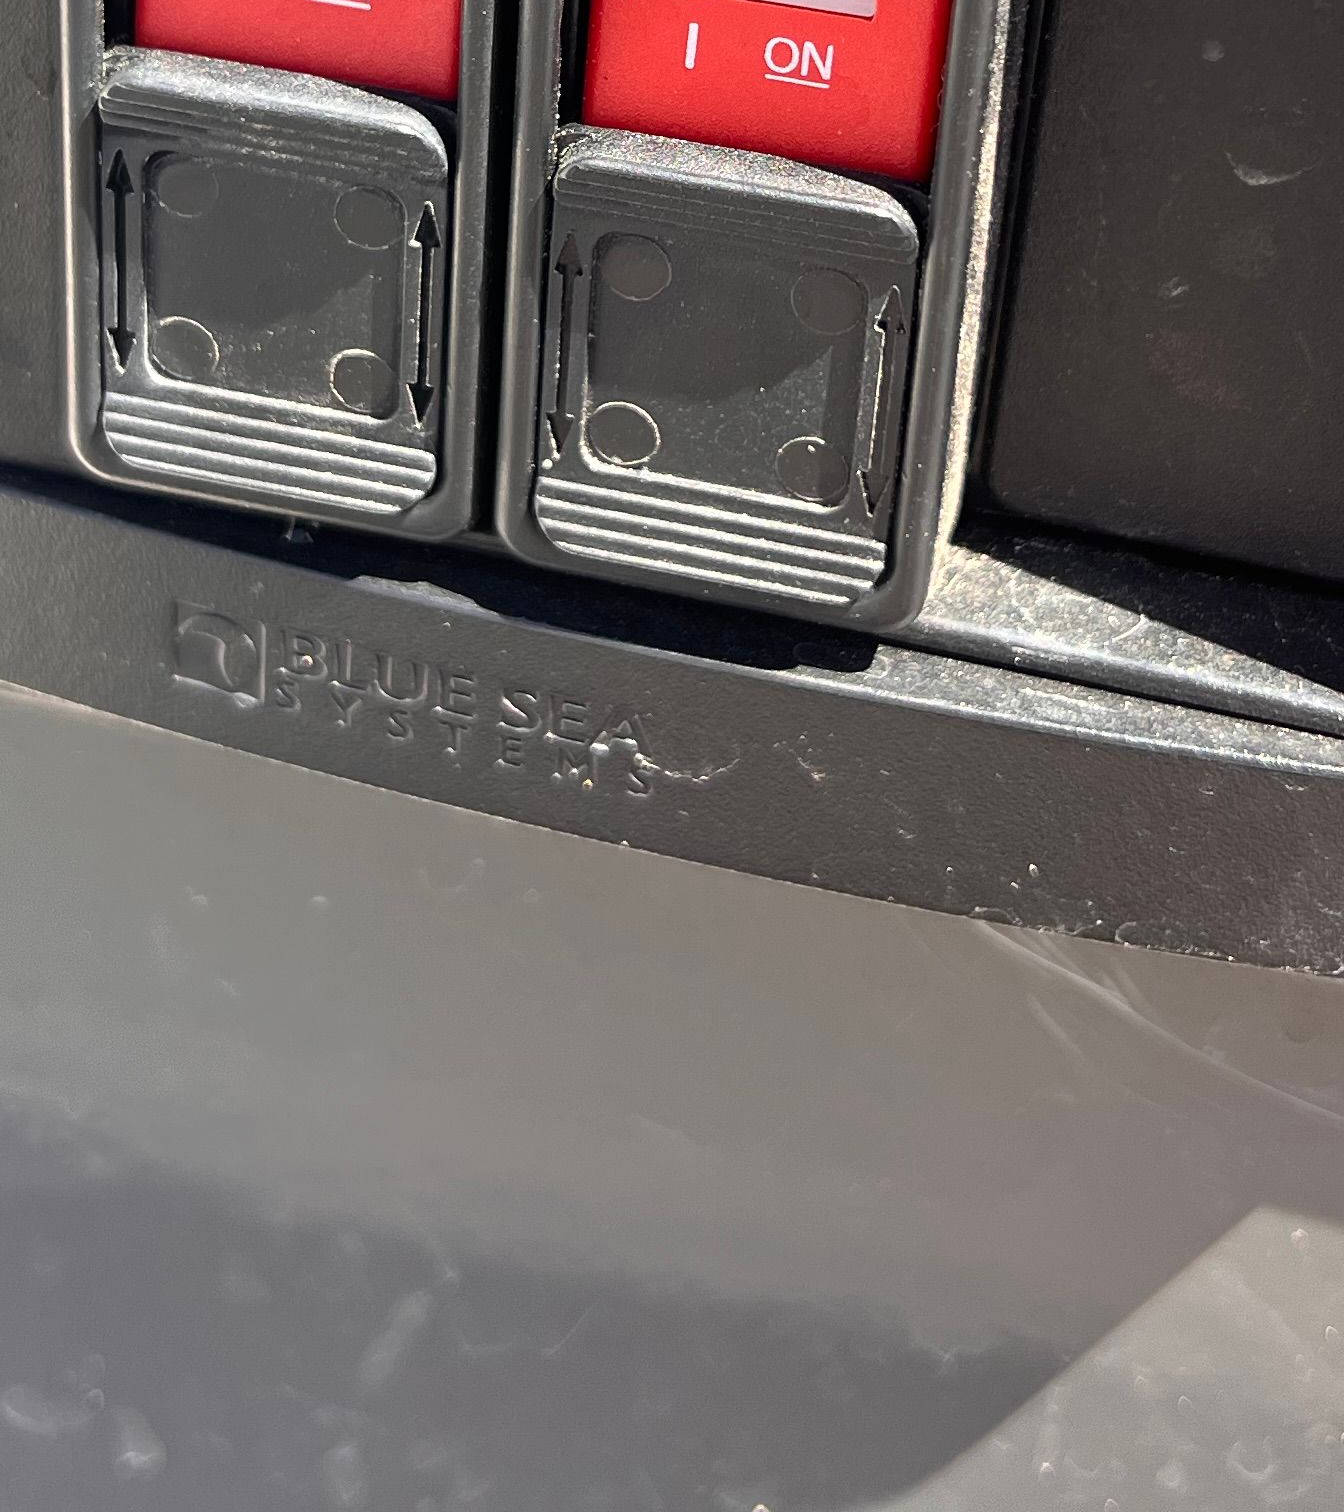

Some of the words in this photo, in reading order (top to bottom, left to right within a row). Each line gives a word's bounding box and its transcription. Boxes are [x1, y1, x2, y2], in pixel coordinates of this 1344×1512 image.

[763, 35, 836, 84] ON
[276, 677, 655, 799] SYSTEMS
[279, 628, 478, 719] BLUE
[499, 687, 653, 758] SEA
